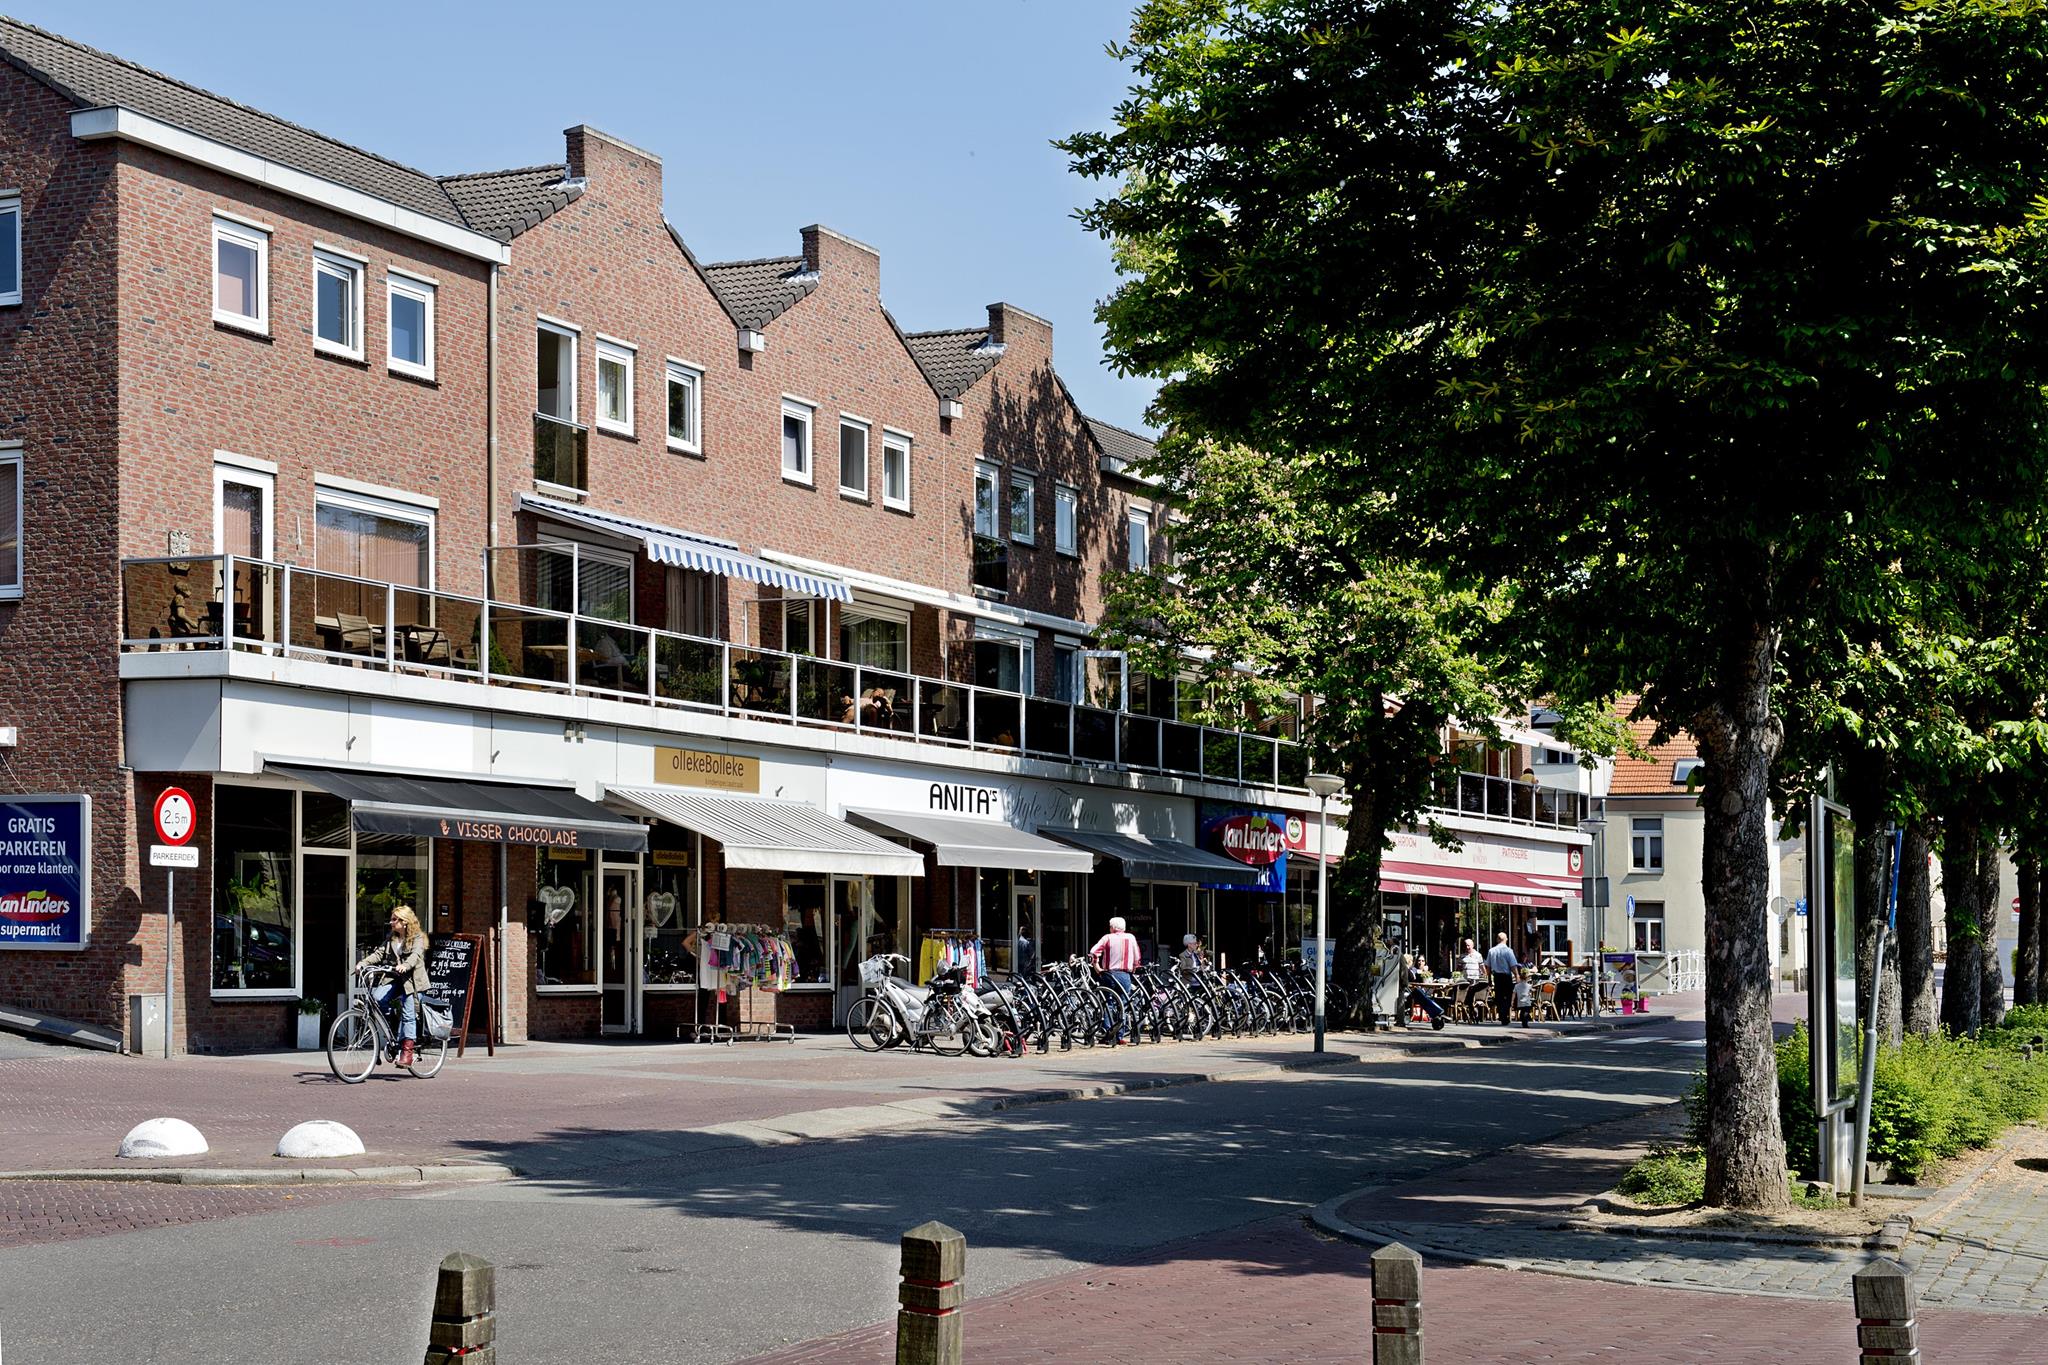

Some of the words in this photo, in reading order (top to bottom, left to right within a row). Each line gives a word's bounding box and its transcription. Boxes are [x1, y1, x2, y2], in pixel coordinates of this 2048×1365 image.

[672, 750, 744, 777] ollekeBolleke
[8, 818, 55, 833] GRATIS
[457, 821, 503, 840] VISSER
[508, 826, 578, 846] CHOCOLADE
[1223, 824, 1243, 849] Jan
[1244, 824, 1286, 853] Linders
[153, 852, 196, 862] PARKEERDEK
[13, 864, 36, 874] onze
[38, 862, 74, 874] klanten
[20, 896, 70, 914] Linders
[0, 923, 61, 938] supermarkt
